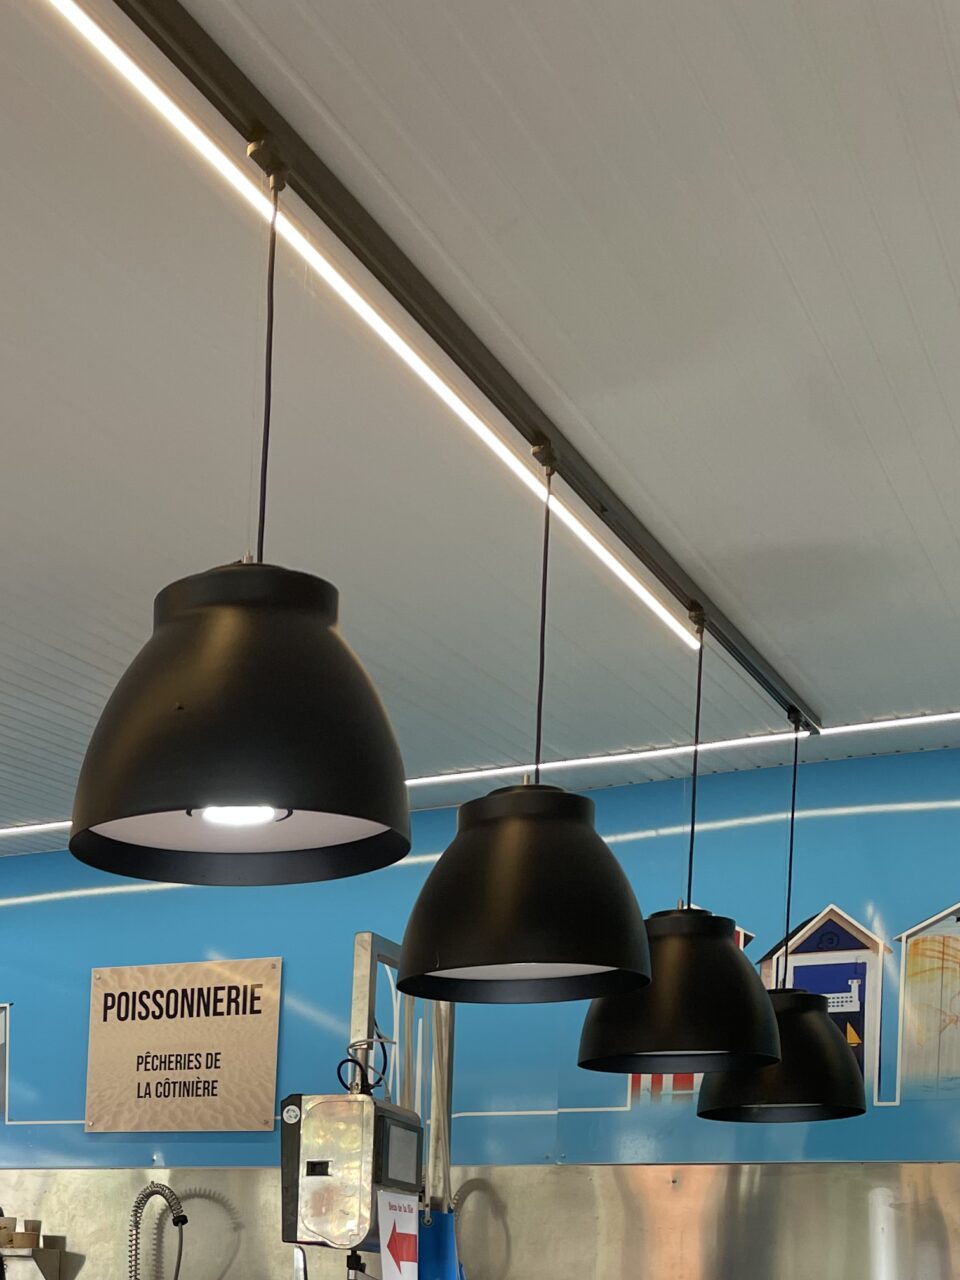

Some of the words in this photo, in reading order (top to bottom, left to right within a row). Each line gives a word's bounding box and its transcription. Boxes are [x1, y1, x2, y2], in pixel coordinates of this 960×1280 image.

[102, 983, 263, 1023] POISSONNERIE
[136, 1051, 202, 1072] PÊCHERIES
[205, 1052, 221, 1070] DE
[137, 1081, 152, 1099] LA
[155, 1077, 218, 1099] CÔTINIÈRE
